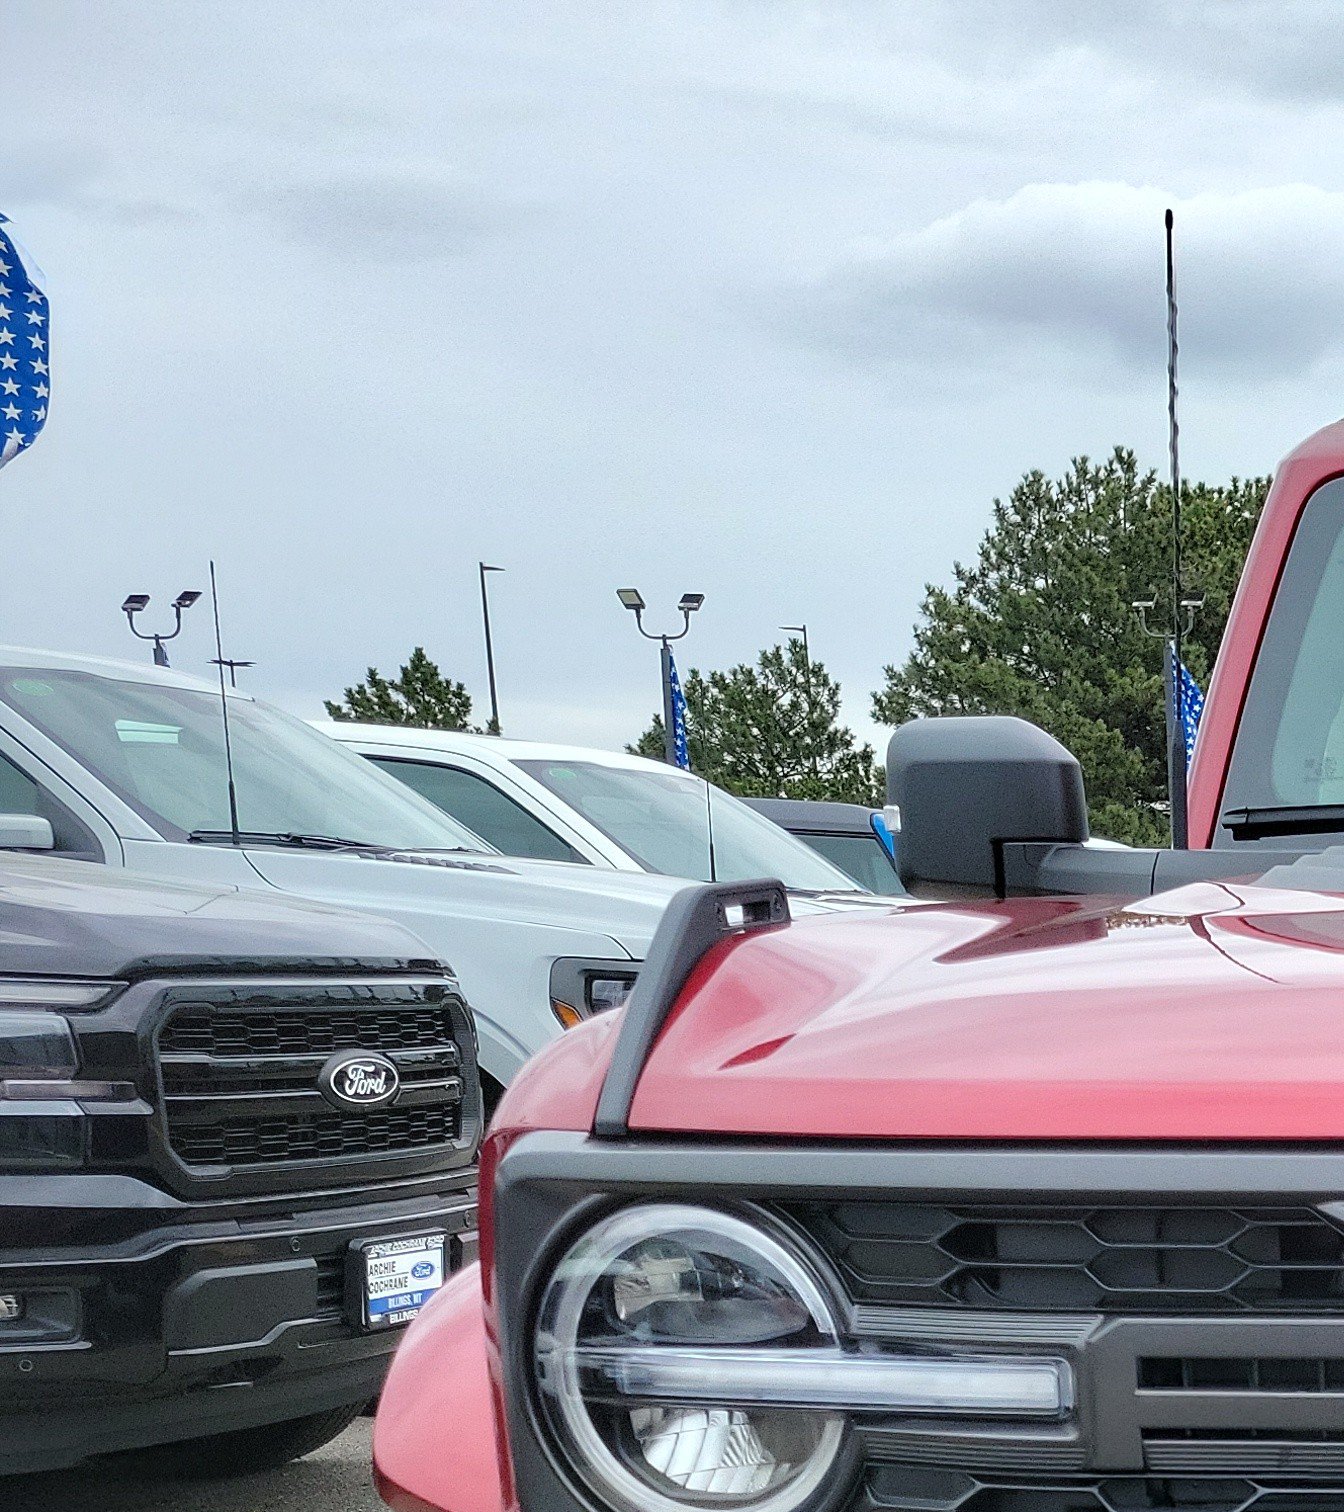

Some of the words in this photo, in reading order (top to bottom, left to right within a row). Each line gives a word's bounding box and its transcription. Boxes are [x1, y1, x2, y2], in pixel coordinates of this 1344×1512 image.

[344, 1064, 387, 1096] Ford
[369, 1261, 397, 1276] ARCHIE
[368, 1276, 409, 1294] COCHRANE
